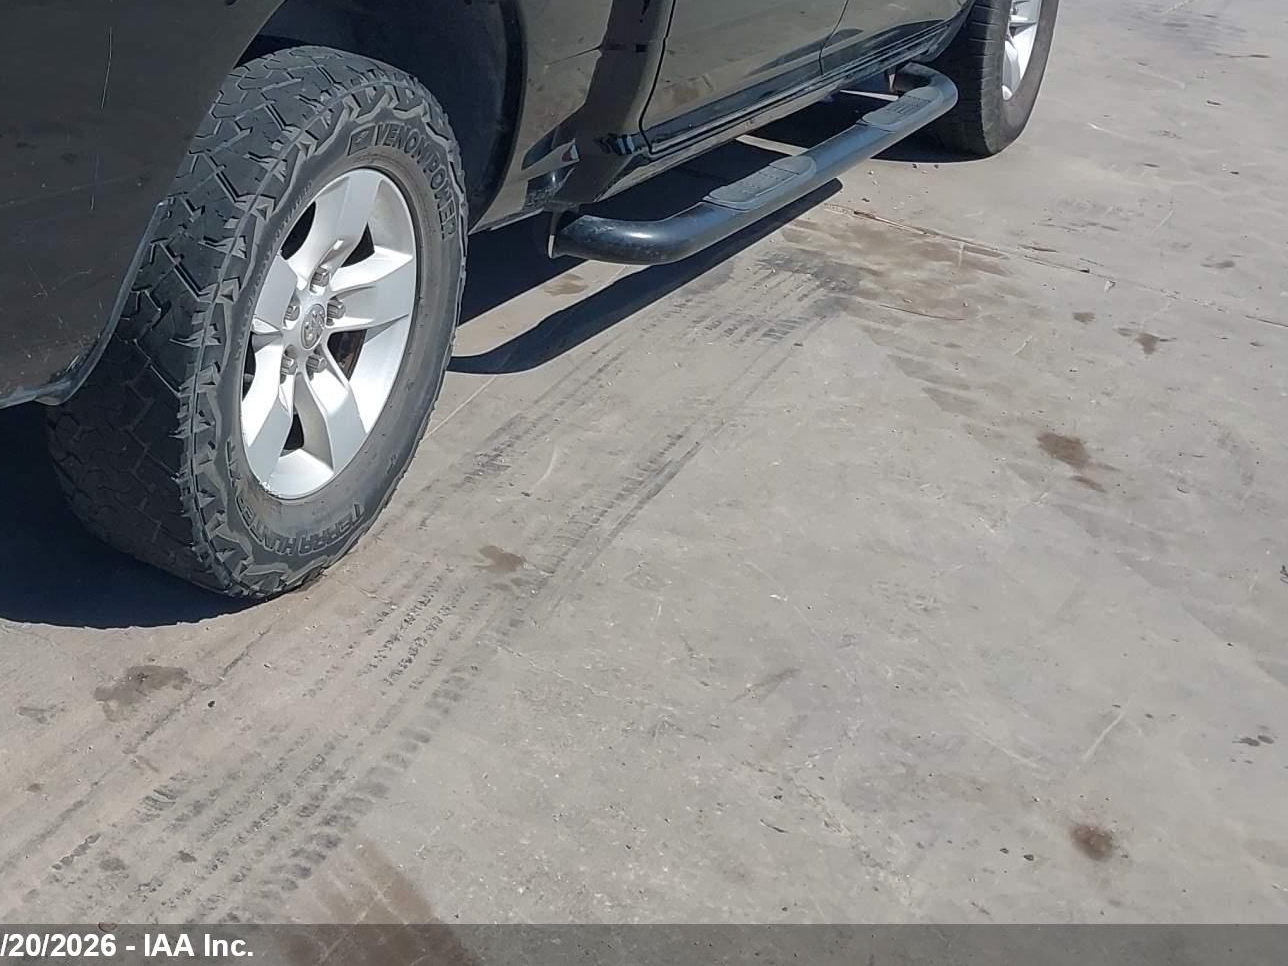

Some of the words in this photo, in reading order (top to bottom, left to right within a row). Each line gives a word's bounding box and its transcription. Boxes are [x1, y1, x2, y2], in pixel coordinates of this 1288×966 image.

[373, 121, 430, 165] VENOM
[421, 149, 458, 241] POWER
[234, 491, 300, 556] HUNTER
[296, 501, 365, 557] TERRA
